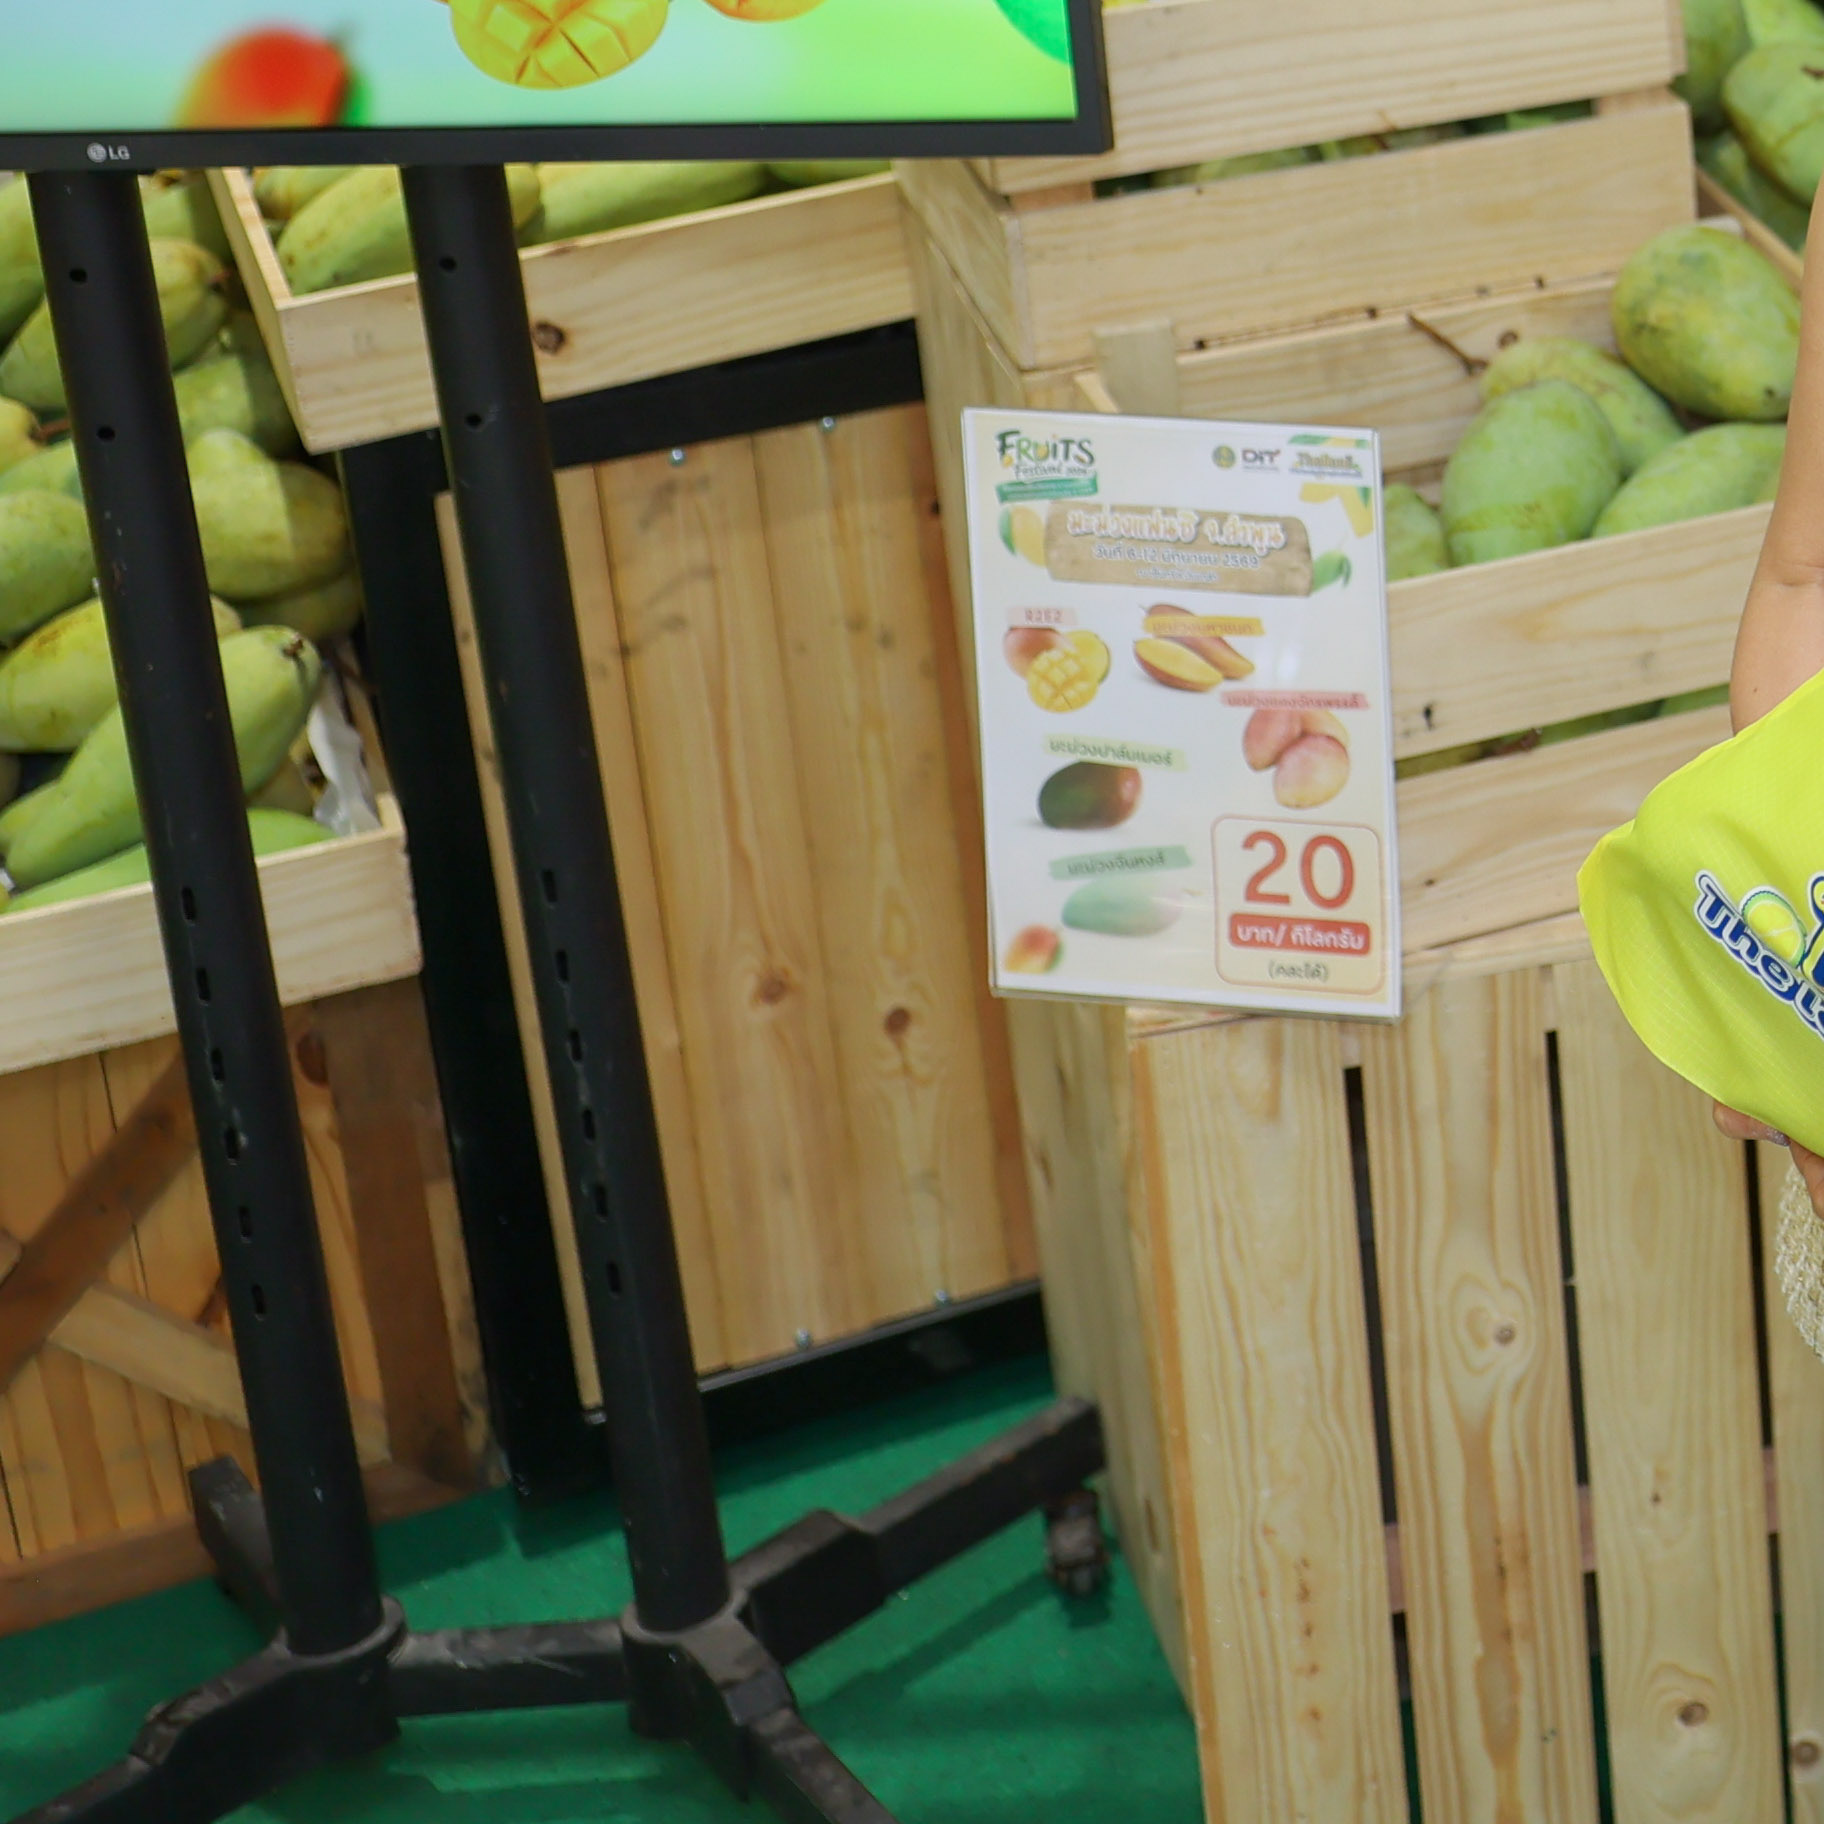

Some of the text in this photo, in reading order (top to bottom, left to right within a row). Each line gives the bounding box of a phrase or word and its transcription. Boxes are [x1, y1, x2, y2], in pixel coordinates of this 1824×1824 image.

[108, 144, 131, 161] LG
[1242, 829, 1355, 911] 20
[1290, 922, 1365, 950] กิโลกรัม
[1698, 877, 1797, 1001] The
